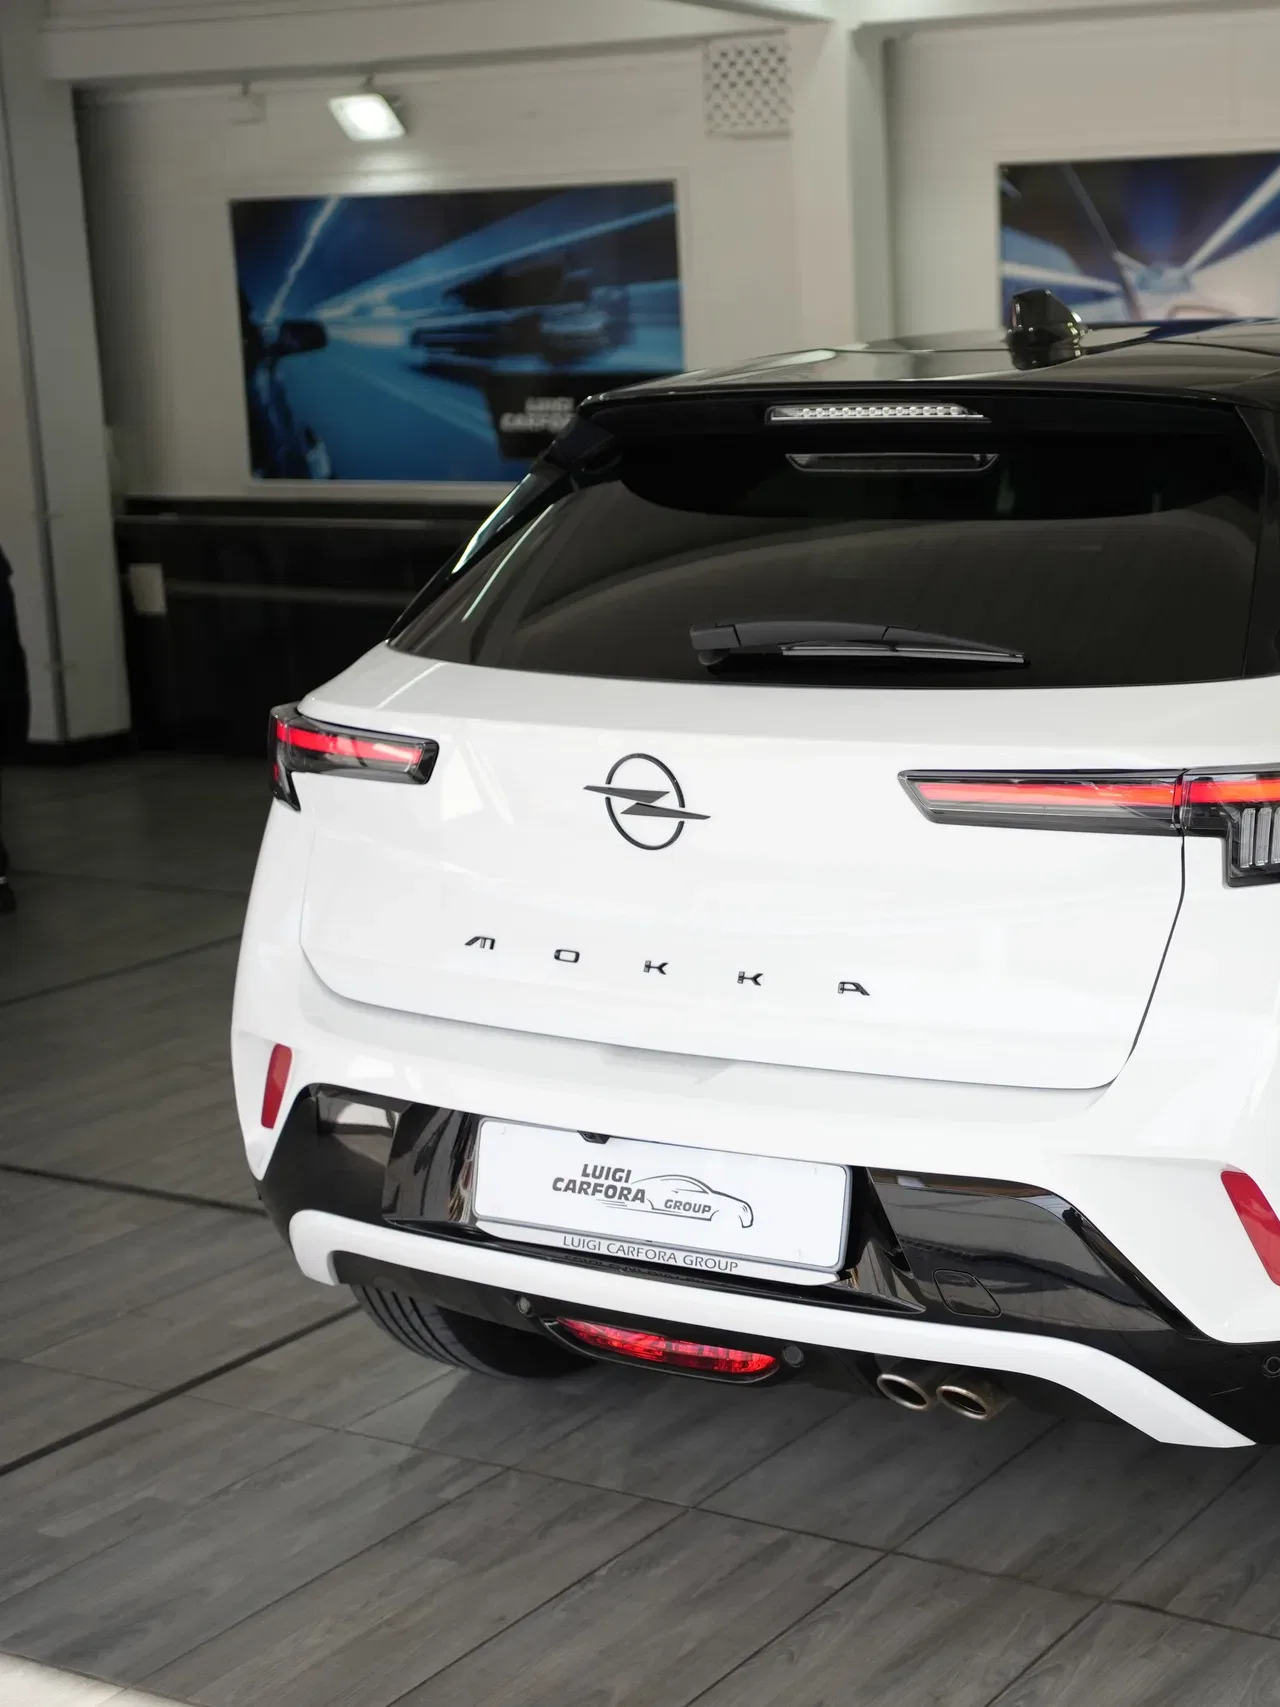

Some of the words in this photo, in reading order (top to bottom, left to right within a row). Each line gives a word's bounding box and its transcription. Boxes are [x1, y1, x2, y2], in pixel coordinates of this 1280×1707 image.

[465, 936, 870, 996] MOKKA
[581, 1163, 632, 1184] LUIGI
[552, 1177, 646, 1203] CARFORA
[664, 1199, 712, 1214] GROUP
[563, 1235, 602, 1251] LUIGI
[606, 1243, 678, 1264] CARFORA
[683, 1255, 739, 1273] GROUP
